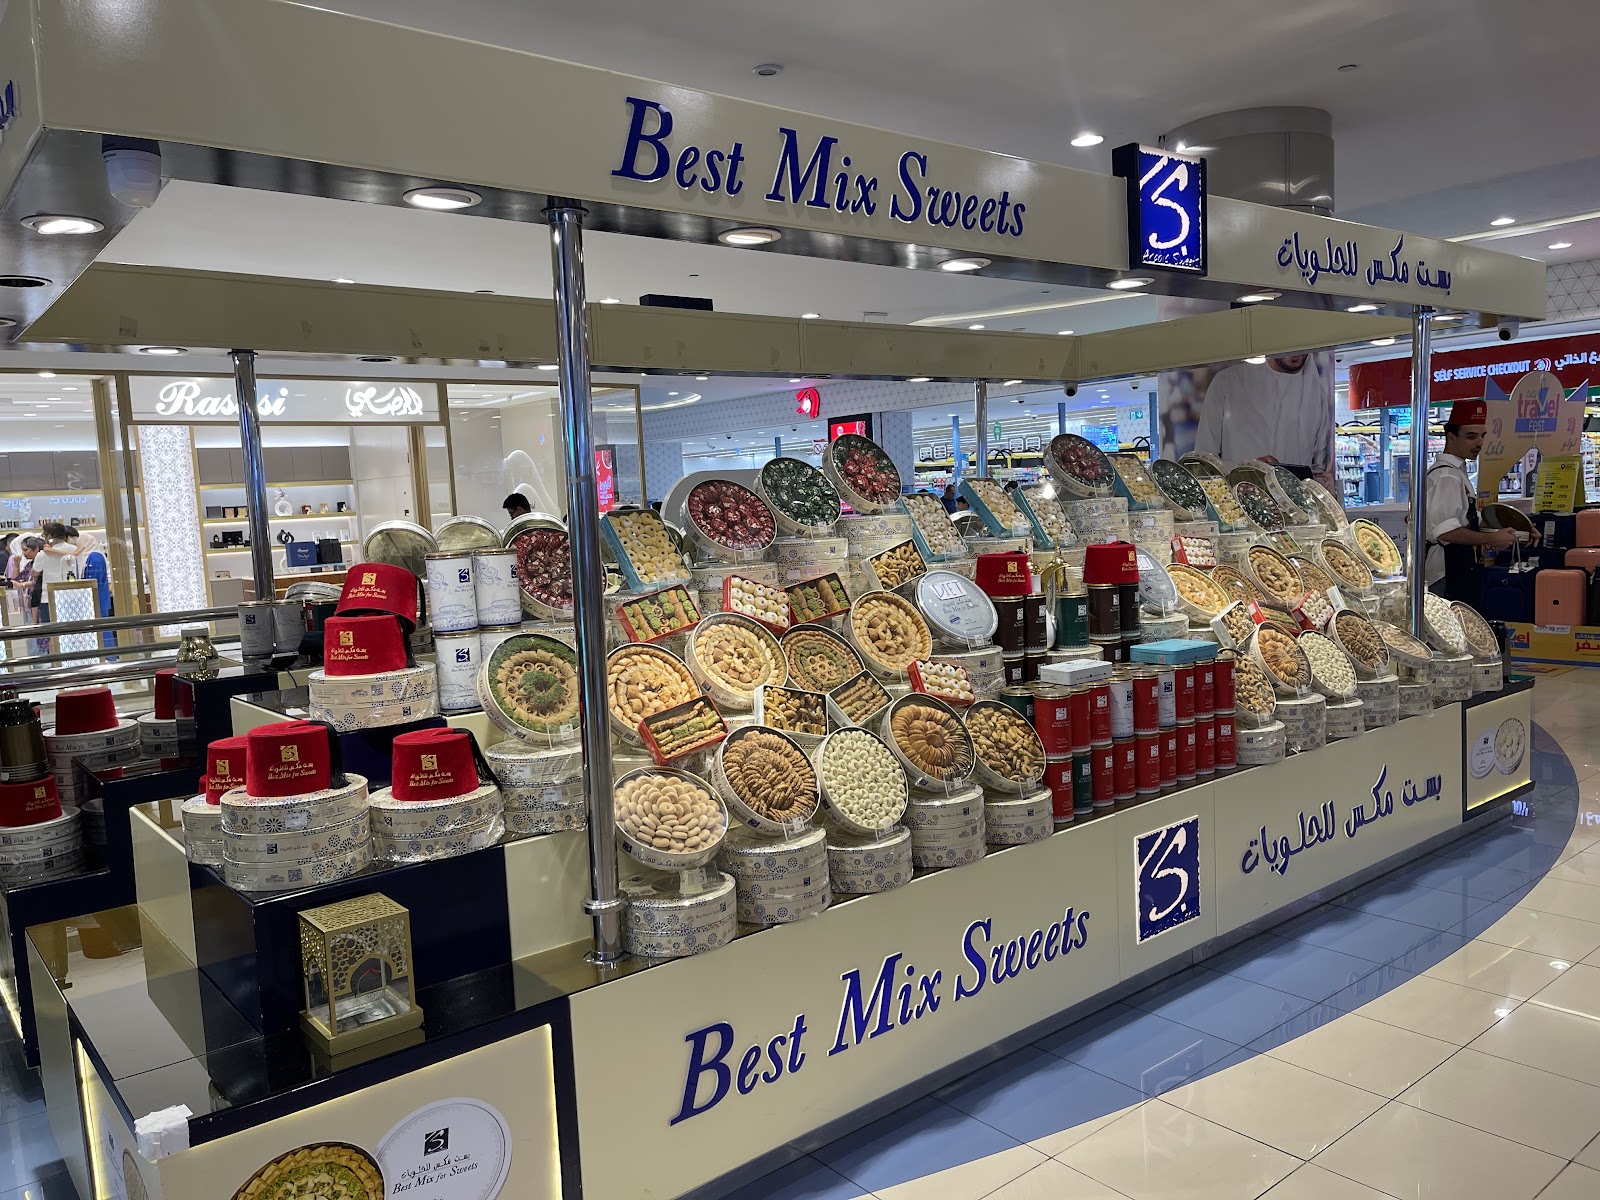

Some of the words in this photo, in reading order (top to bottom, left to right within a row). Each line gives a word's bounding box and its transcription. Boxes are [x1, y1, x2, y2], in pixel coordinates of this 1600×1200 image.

[609, 96, 745, 197] Best
[765, 127, 878, 217] Mix
[890, 151, 1026, 237] Sweets
[1277, 231, 1358, 285] للحلويات
[1366, 234, 1409, 286] مكس
[1416, 260, 1451, 295] بست
[1433, 369, 1453, 382] SELF
[1454, 365, 1487, 380] SERVICE
[1487, 360, 1531, 376] CHECKOUT
[155, 381, 289, 416] Rassi
[1517, 389, 1561, 418] travel
[1528, 419, 1546, 431] fest
[932, 581, 964, 598] DIET
[1344, 764, 1394, 839] مكس
[1401, 774, 1442, 807] بست
[1241, 800, 1335, 876] للحلويات
[669, 1020, 808, 1127] Best
[827, 952, 942, 1057] Mix
[953, 907, 1090, 1002] Sweets
[392, 1182, 412, 1195] Best
[414, 1173, 435, 1188] Mix
[435, 1172, 447, 1184] for
[449, 1162, 479, 1177] Sweets
